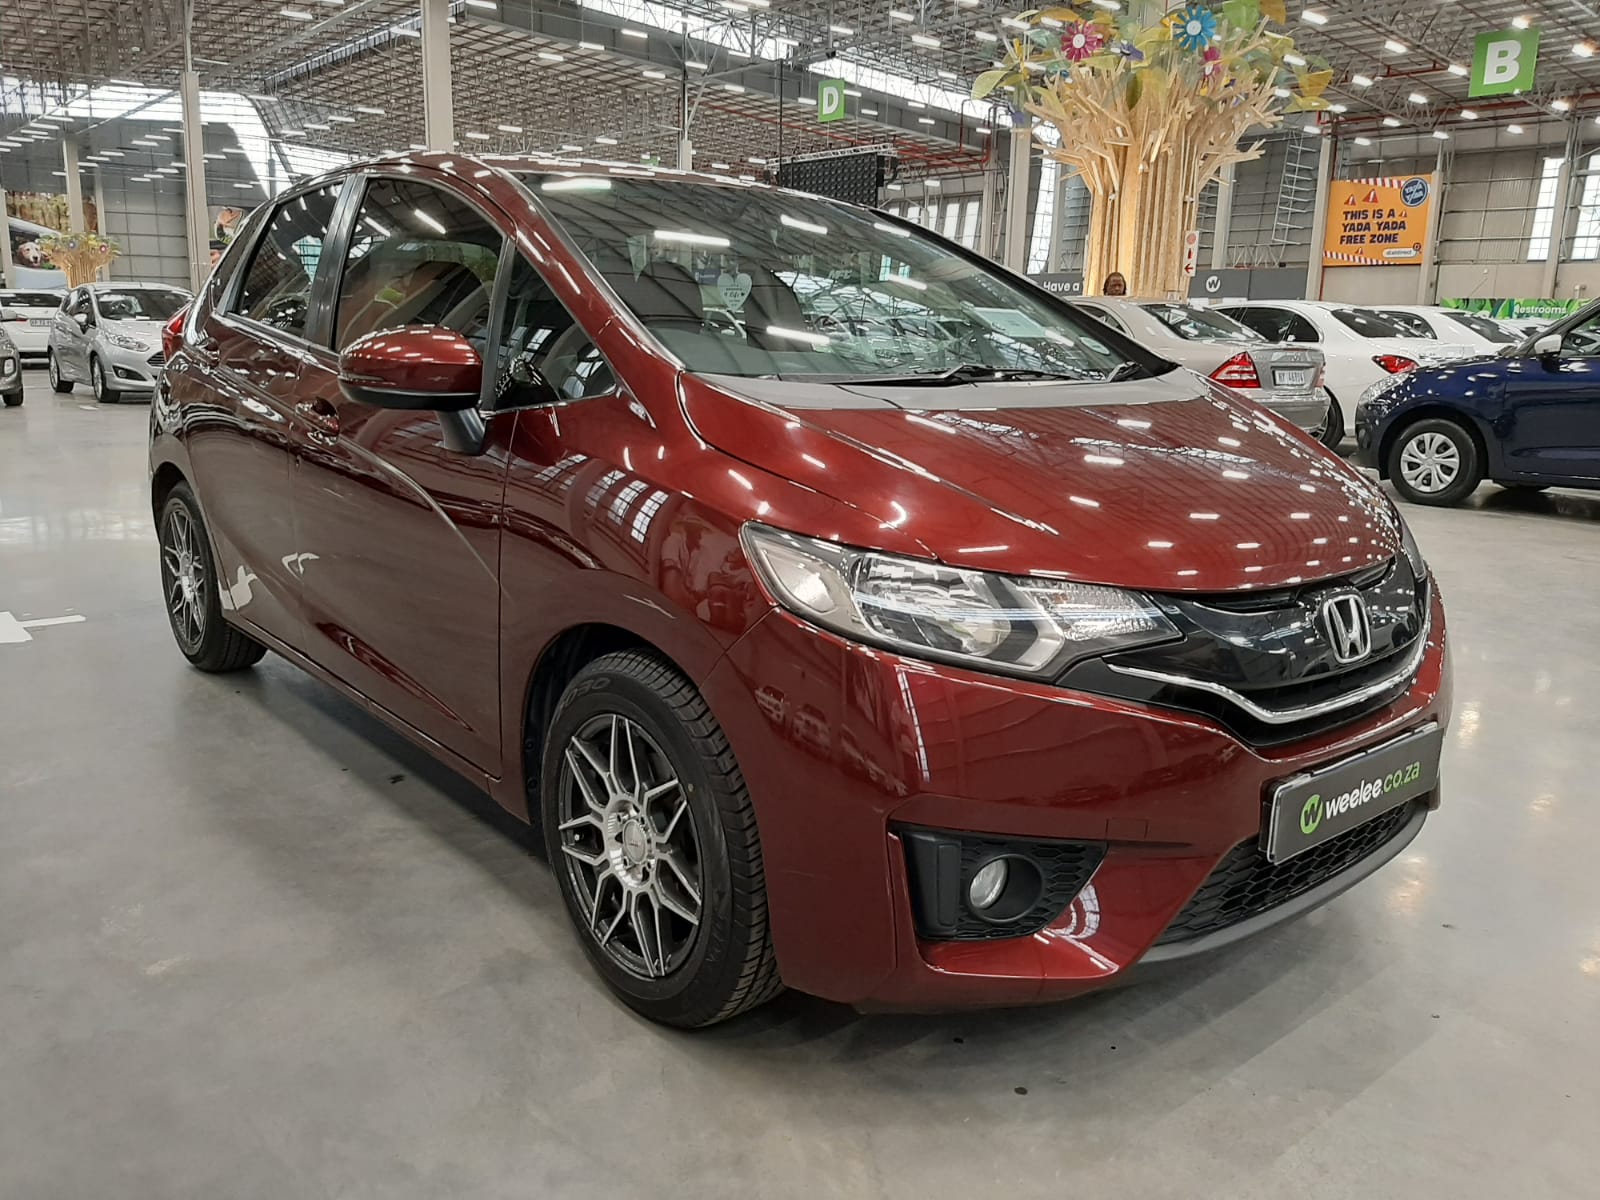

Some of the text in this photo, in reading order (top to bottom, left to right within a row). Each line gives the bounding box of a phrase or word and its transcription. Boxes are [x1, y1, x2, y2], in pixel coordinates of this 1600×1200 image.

[1483, 39, 1522, 85] B
[823, 86, 839, 115] D
[1342, 208, 1396, 221] THIS IS A
[1341, 220, 1407, 232] YADA YADA
[1339, 233, 1399, 245] FREE ZONE
[1072, 282, 1081, 292] a
[1325, 761, 1420, 820] weelee.co.za
